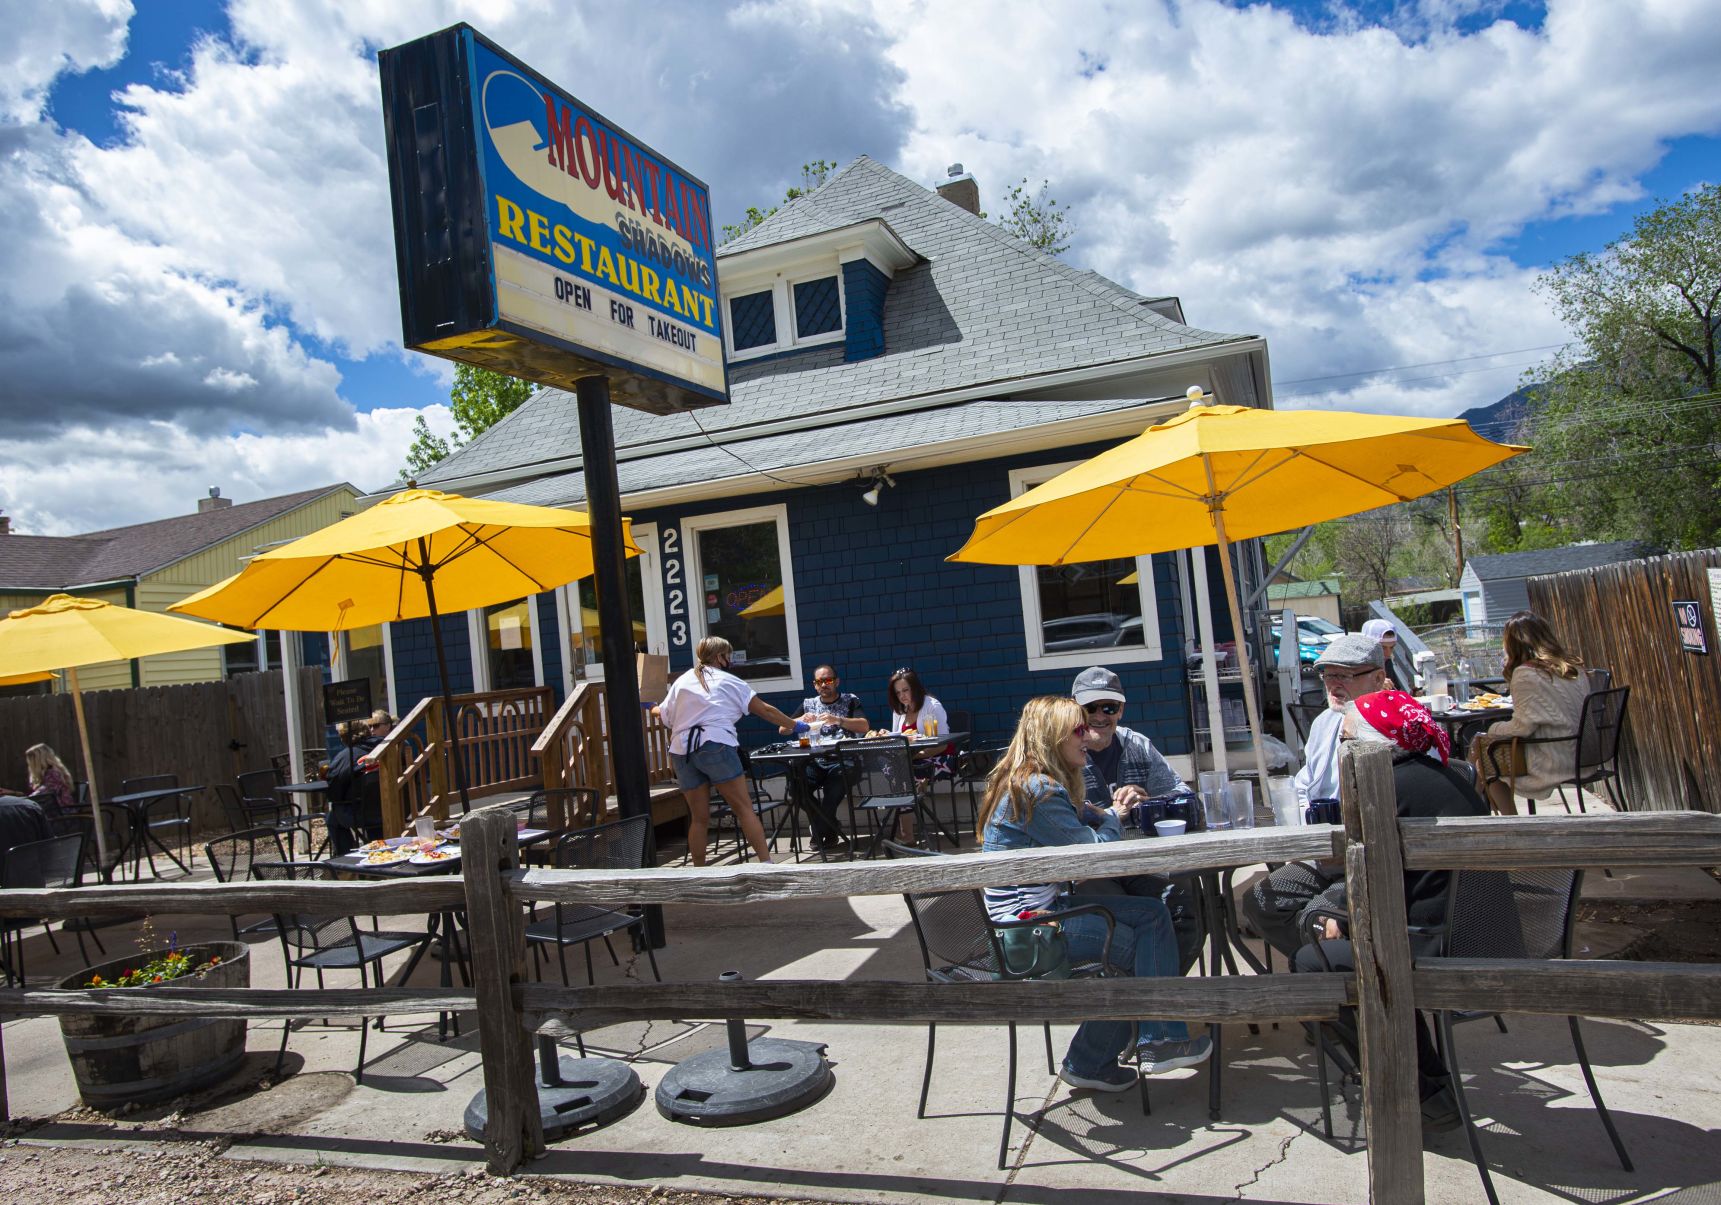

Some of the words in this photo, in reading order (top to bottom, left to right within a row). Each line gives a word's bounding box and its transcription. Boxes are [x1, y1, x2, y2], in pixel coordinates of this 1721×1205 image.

[544, 93, 709, 251] MOUNTAIN
[495, 194, 715, 328] RESTAURANT
[617, 213, 712, 290] SHADOWS
[554, 276, 592, 311] OPEN
[610, 299, 634, 328] FOR
[648, 315, 697, 352] TAKEOUT
[1678, 607, 1688, 625] NO
